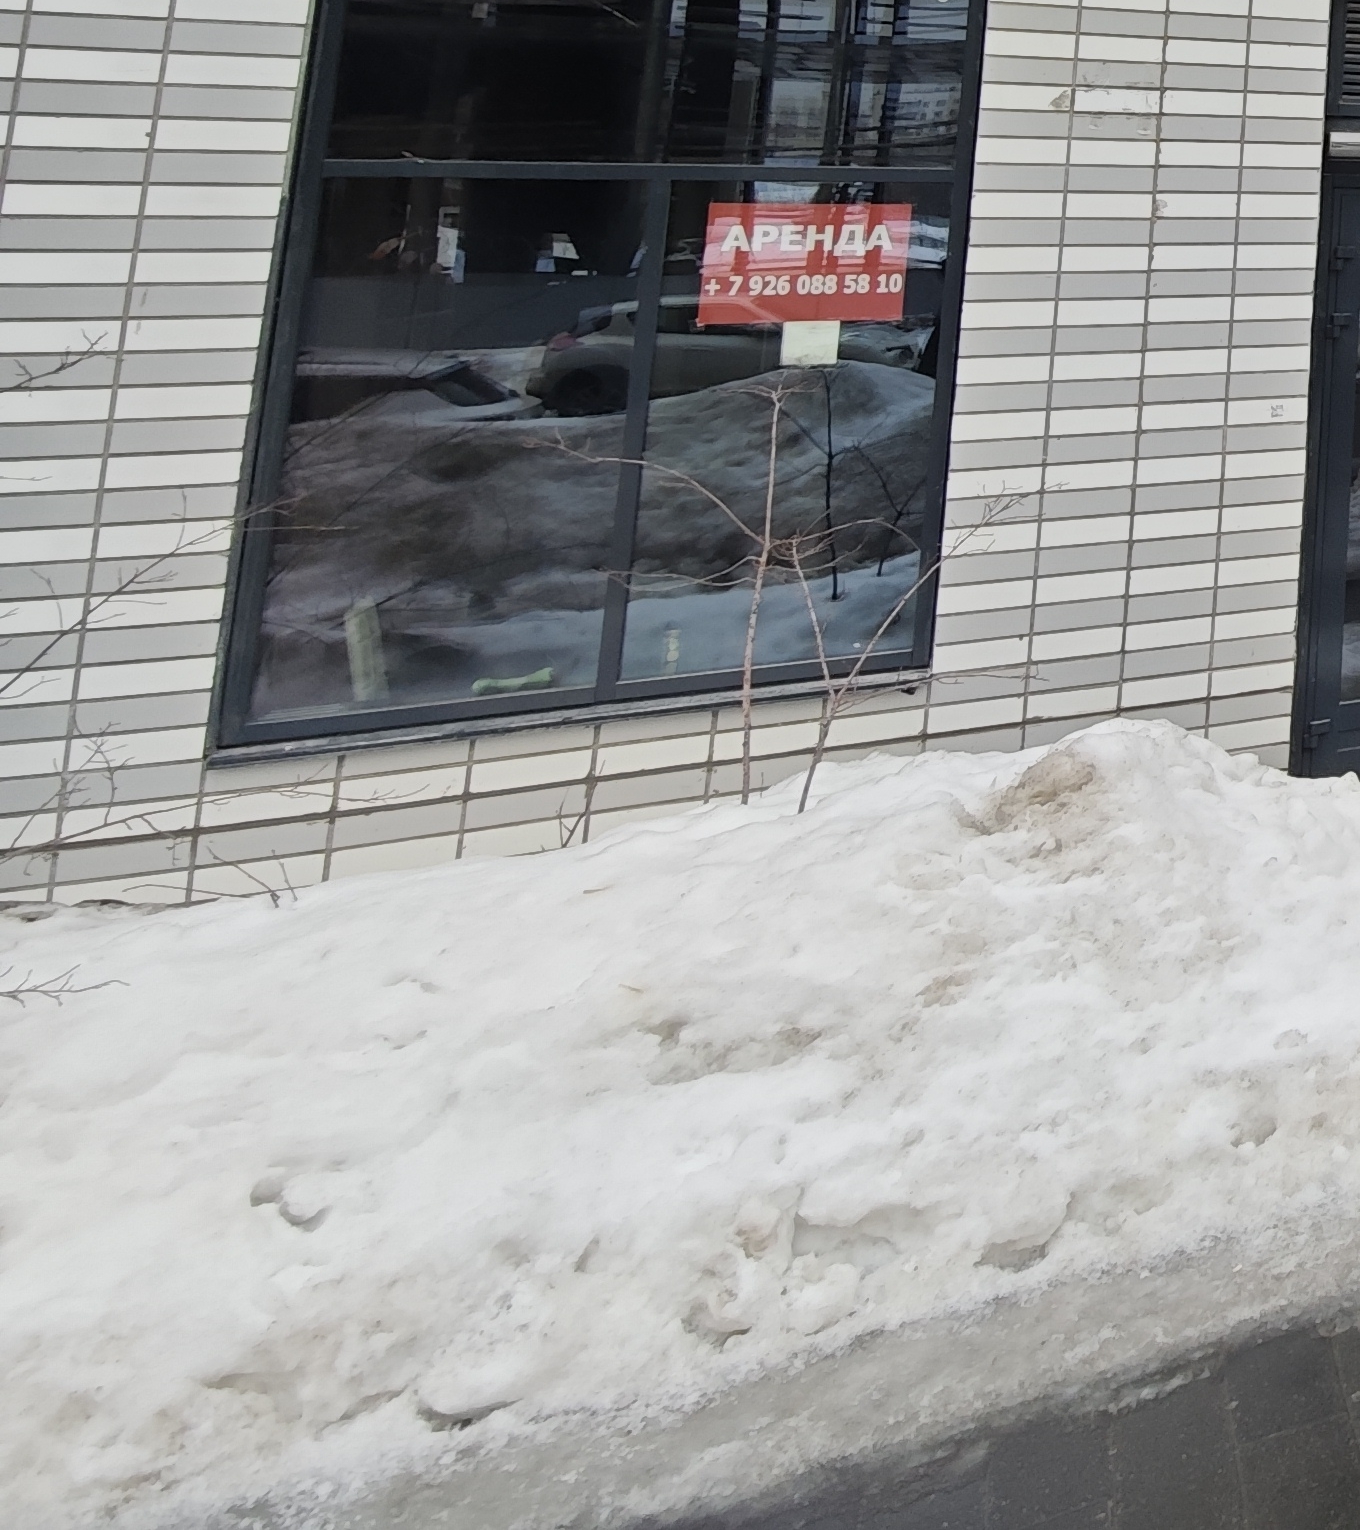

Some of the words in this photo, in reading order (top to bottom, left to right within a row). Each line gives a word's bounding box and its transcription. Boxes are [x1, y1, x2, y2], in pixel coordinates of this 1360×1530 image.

[720, 224, 893, 257] АРЕНДА
[704, 278, 721, 296] +
[728, 275, 743, 296] 7
[749, 275, 791, 296] 926
[797, 274, 838, 295] 088
[843, 274, 870, 294] 58
[876, 273, 902, 293] 10
